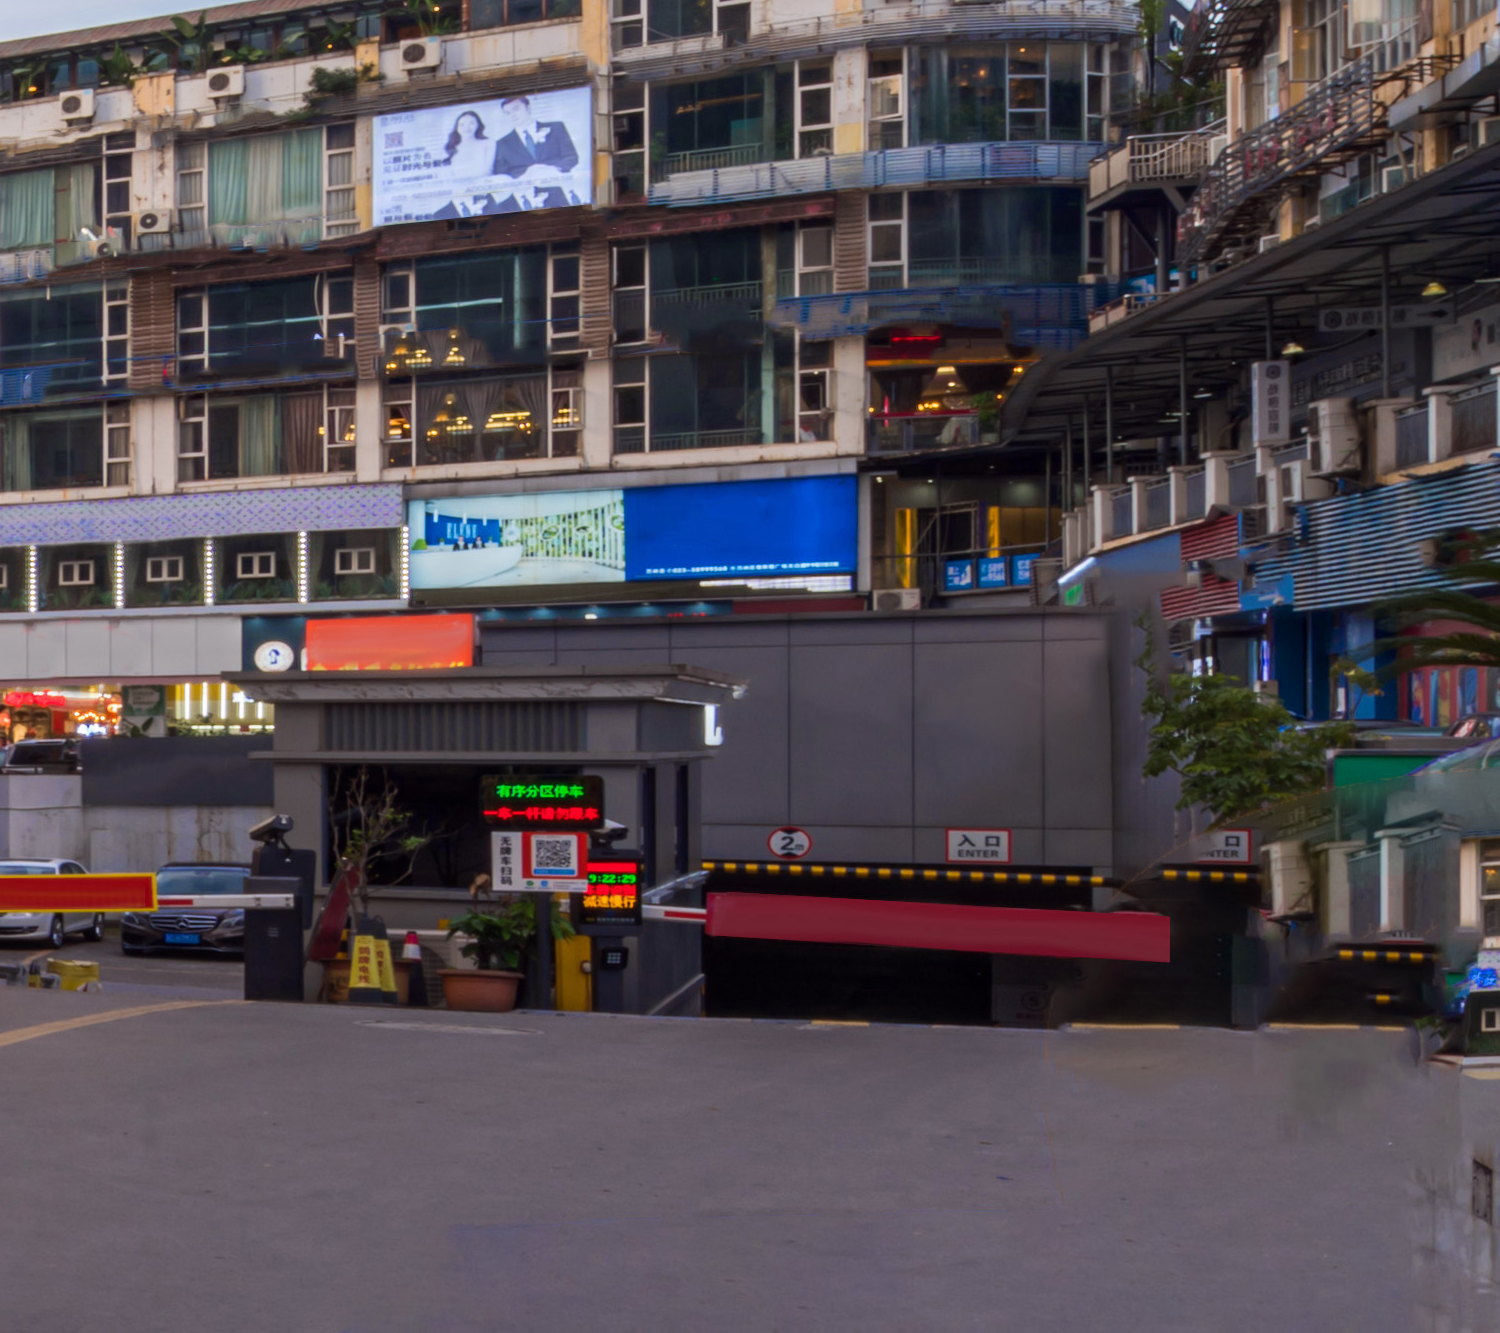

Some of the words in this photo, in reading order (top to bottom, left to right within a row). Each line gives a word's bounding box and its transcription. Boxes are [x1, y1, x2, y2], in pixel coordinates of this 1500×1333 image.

[496, 784, 585, 798] 有序分区停车
[483, 806, 599, 820] 一车一杆请勿跟车
[780, 835, 805, 852] 2m
[957, 834, 1001, 848] 入口
[957, 849, 999, 858] ENTER
[1198, 849, 1240, 858] NTER
[499, 836, 512, 887] 无牌车扫码
[583, 895, 636, 908] 减速慢行
